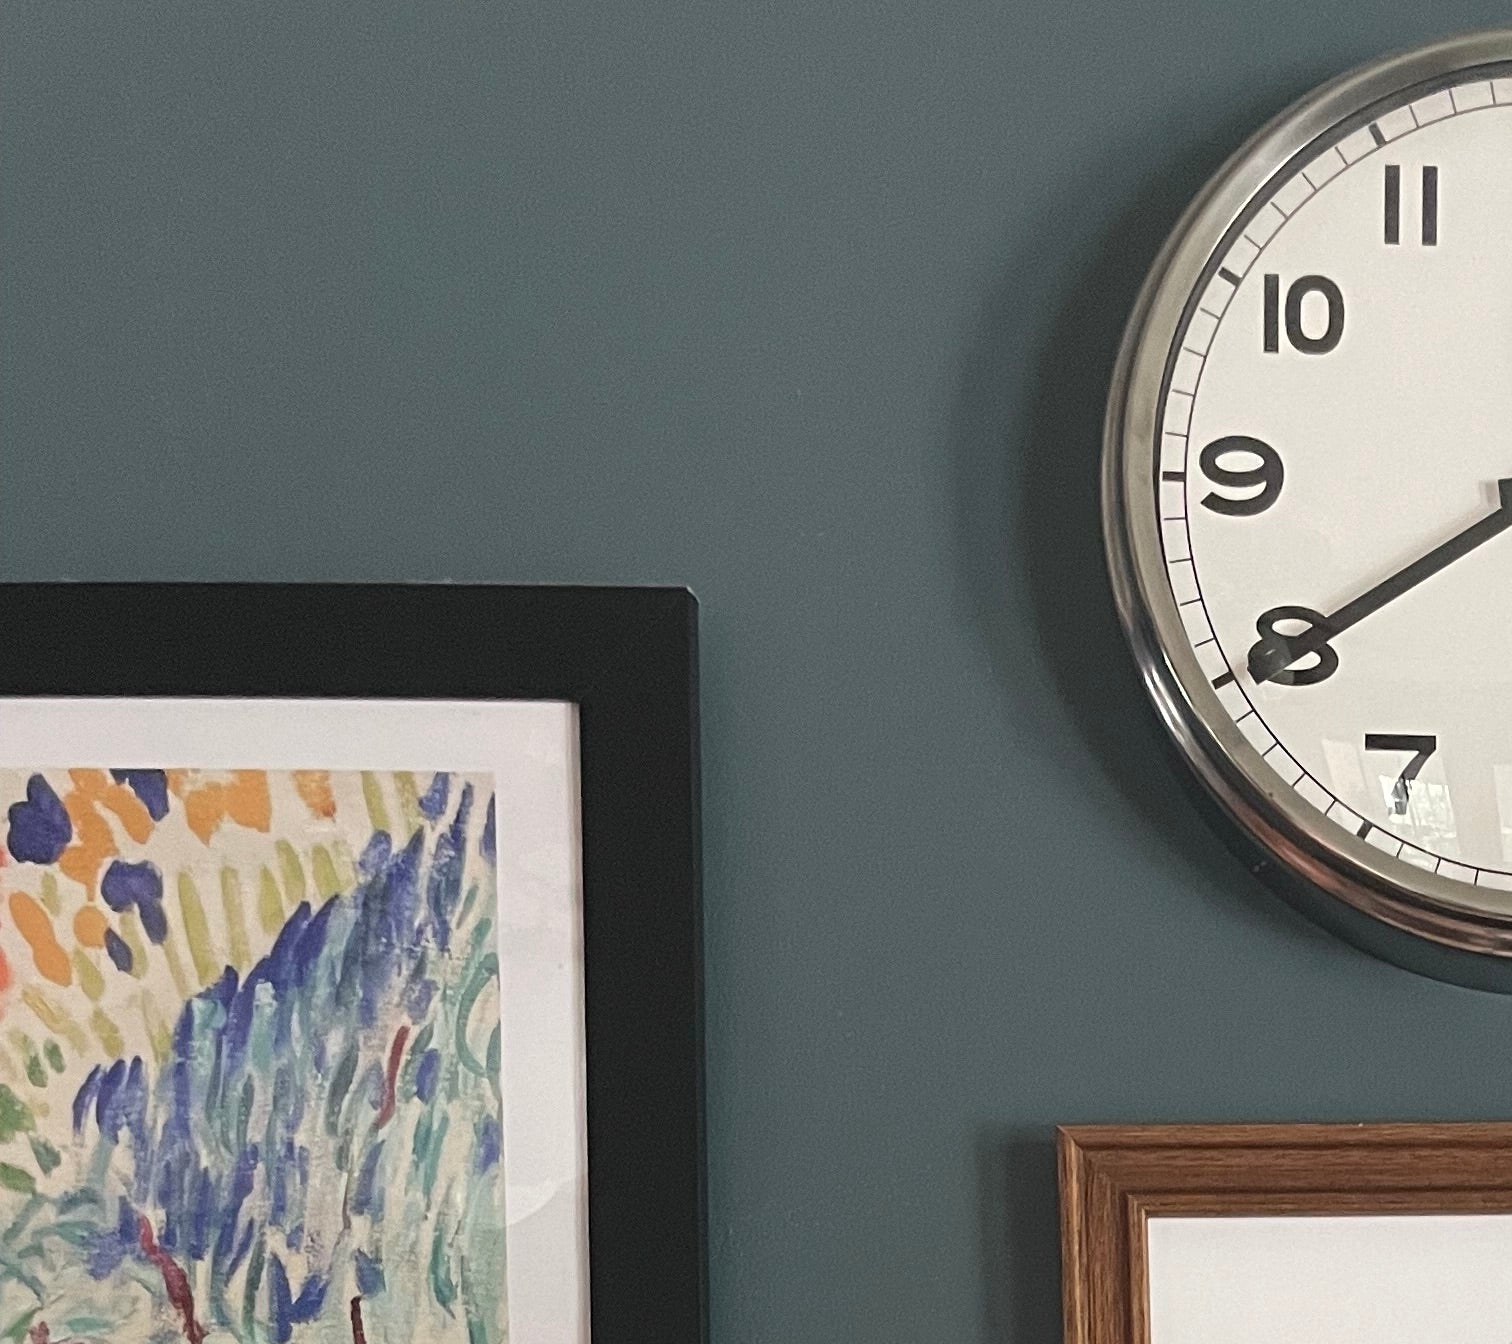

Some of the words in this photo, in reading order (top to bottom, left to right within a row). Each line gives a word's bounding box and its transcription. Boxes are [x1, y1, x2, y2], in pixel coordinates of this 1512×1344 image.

[1384, 164, 1439, 247] 11
[1263, 273, 1345, 355] 10
[1198, 435, 1285, 517] 9
[1248, 605, 1339, 686] 8
[1364, 733, 1437, 814] 7
